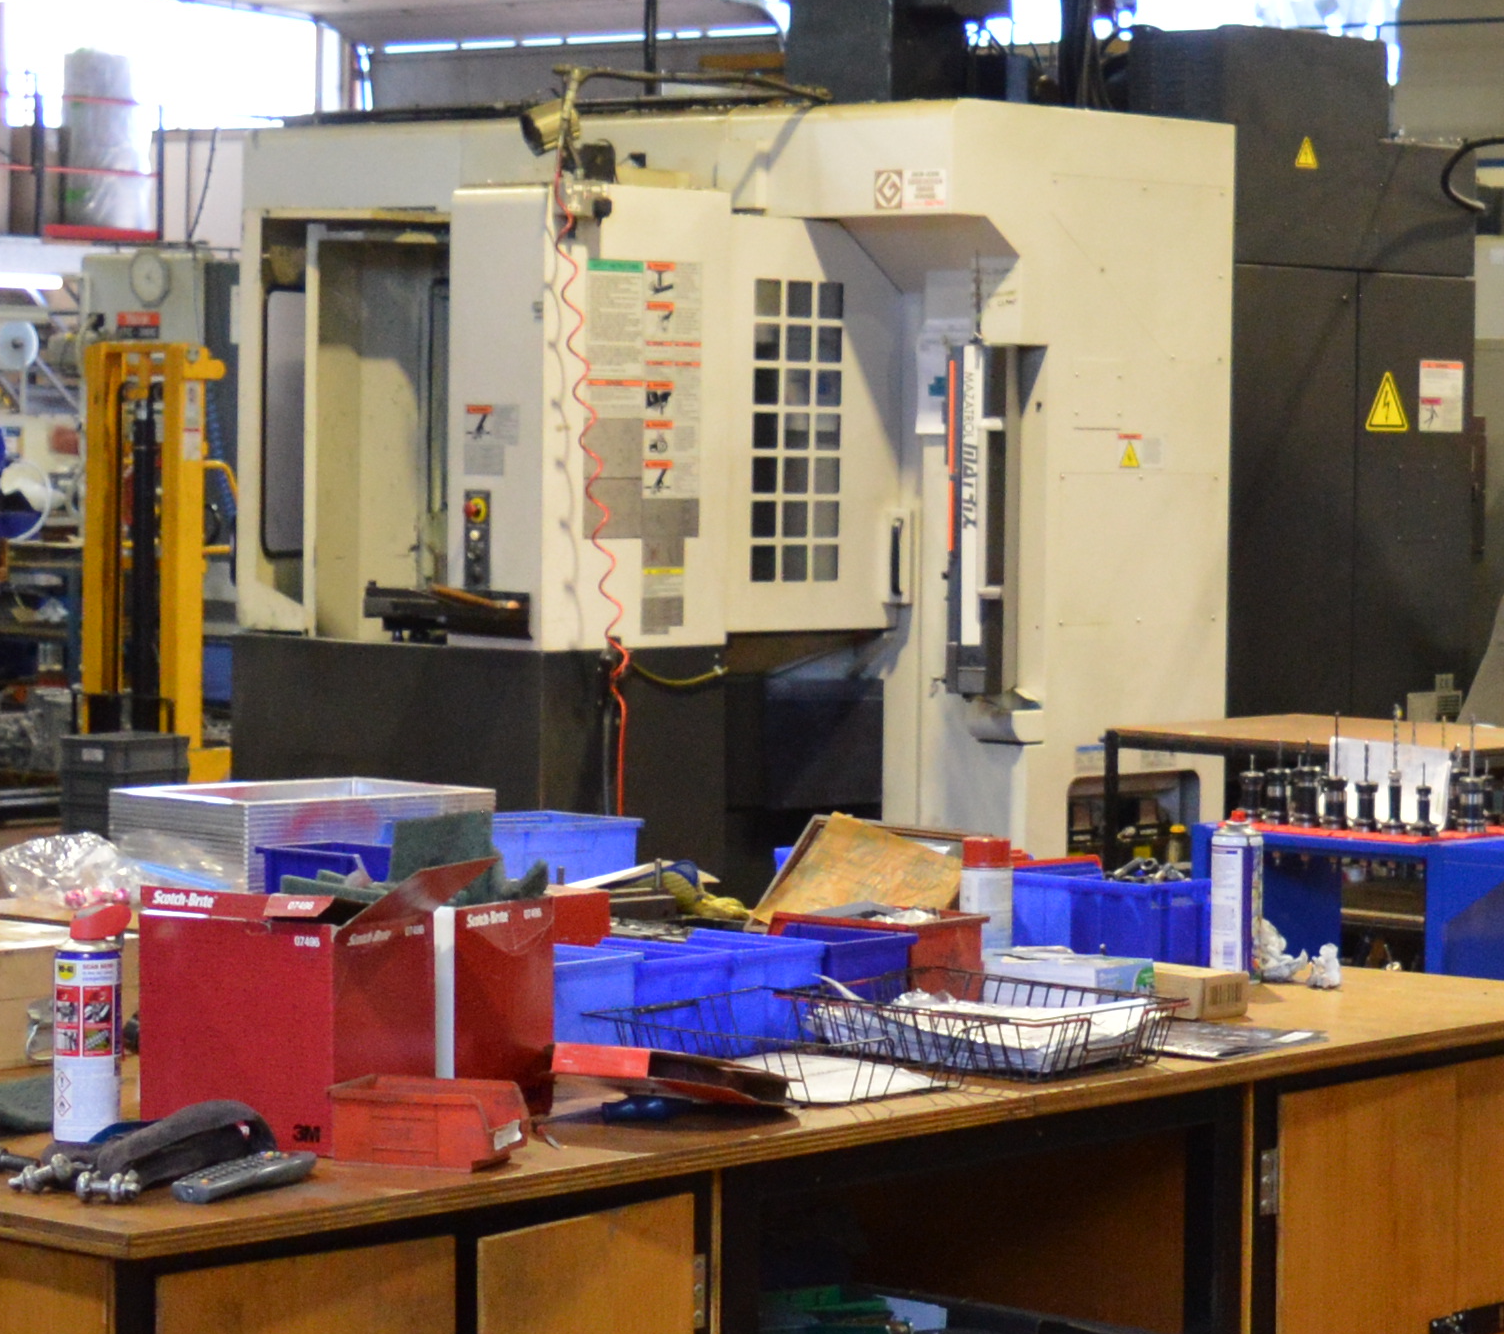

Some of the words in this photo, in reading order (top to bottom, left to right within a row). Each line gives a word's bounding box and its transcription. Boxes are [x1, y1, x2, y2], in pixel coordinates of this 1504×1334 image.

[963, 371, 975, 439] MAZATROL
[152, 890, 215, 908] Scotch-Brite
[466, 910, 510, 928] Scotch-Brite
[347, 930, 392, 946] Scotch-Brite
[292, 1124, 321, 1143] 3M
